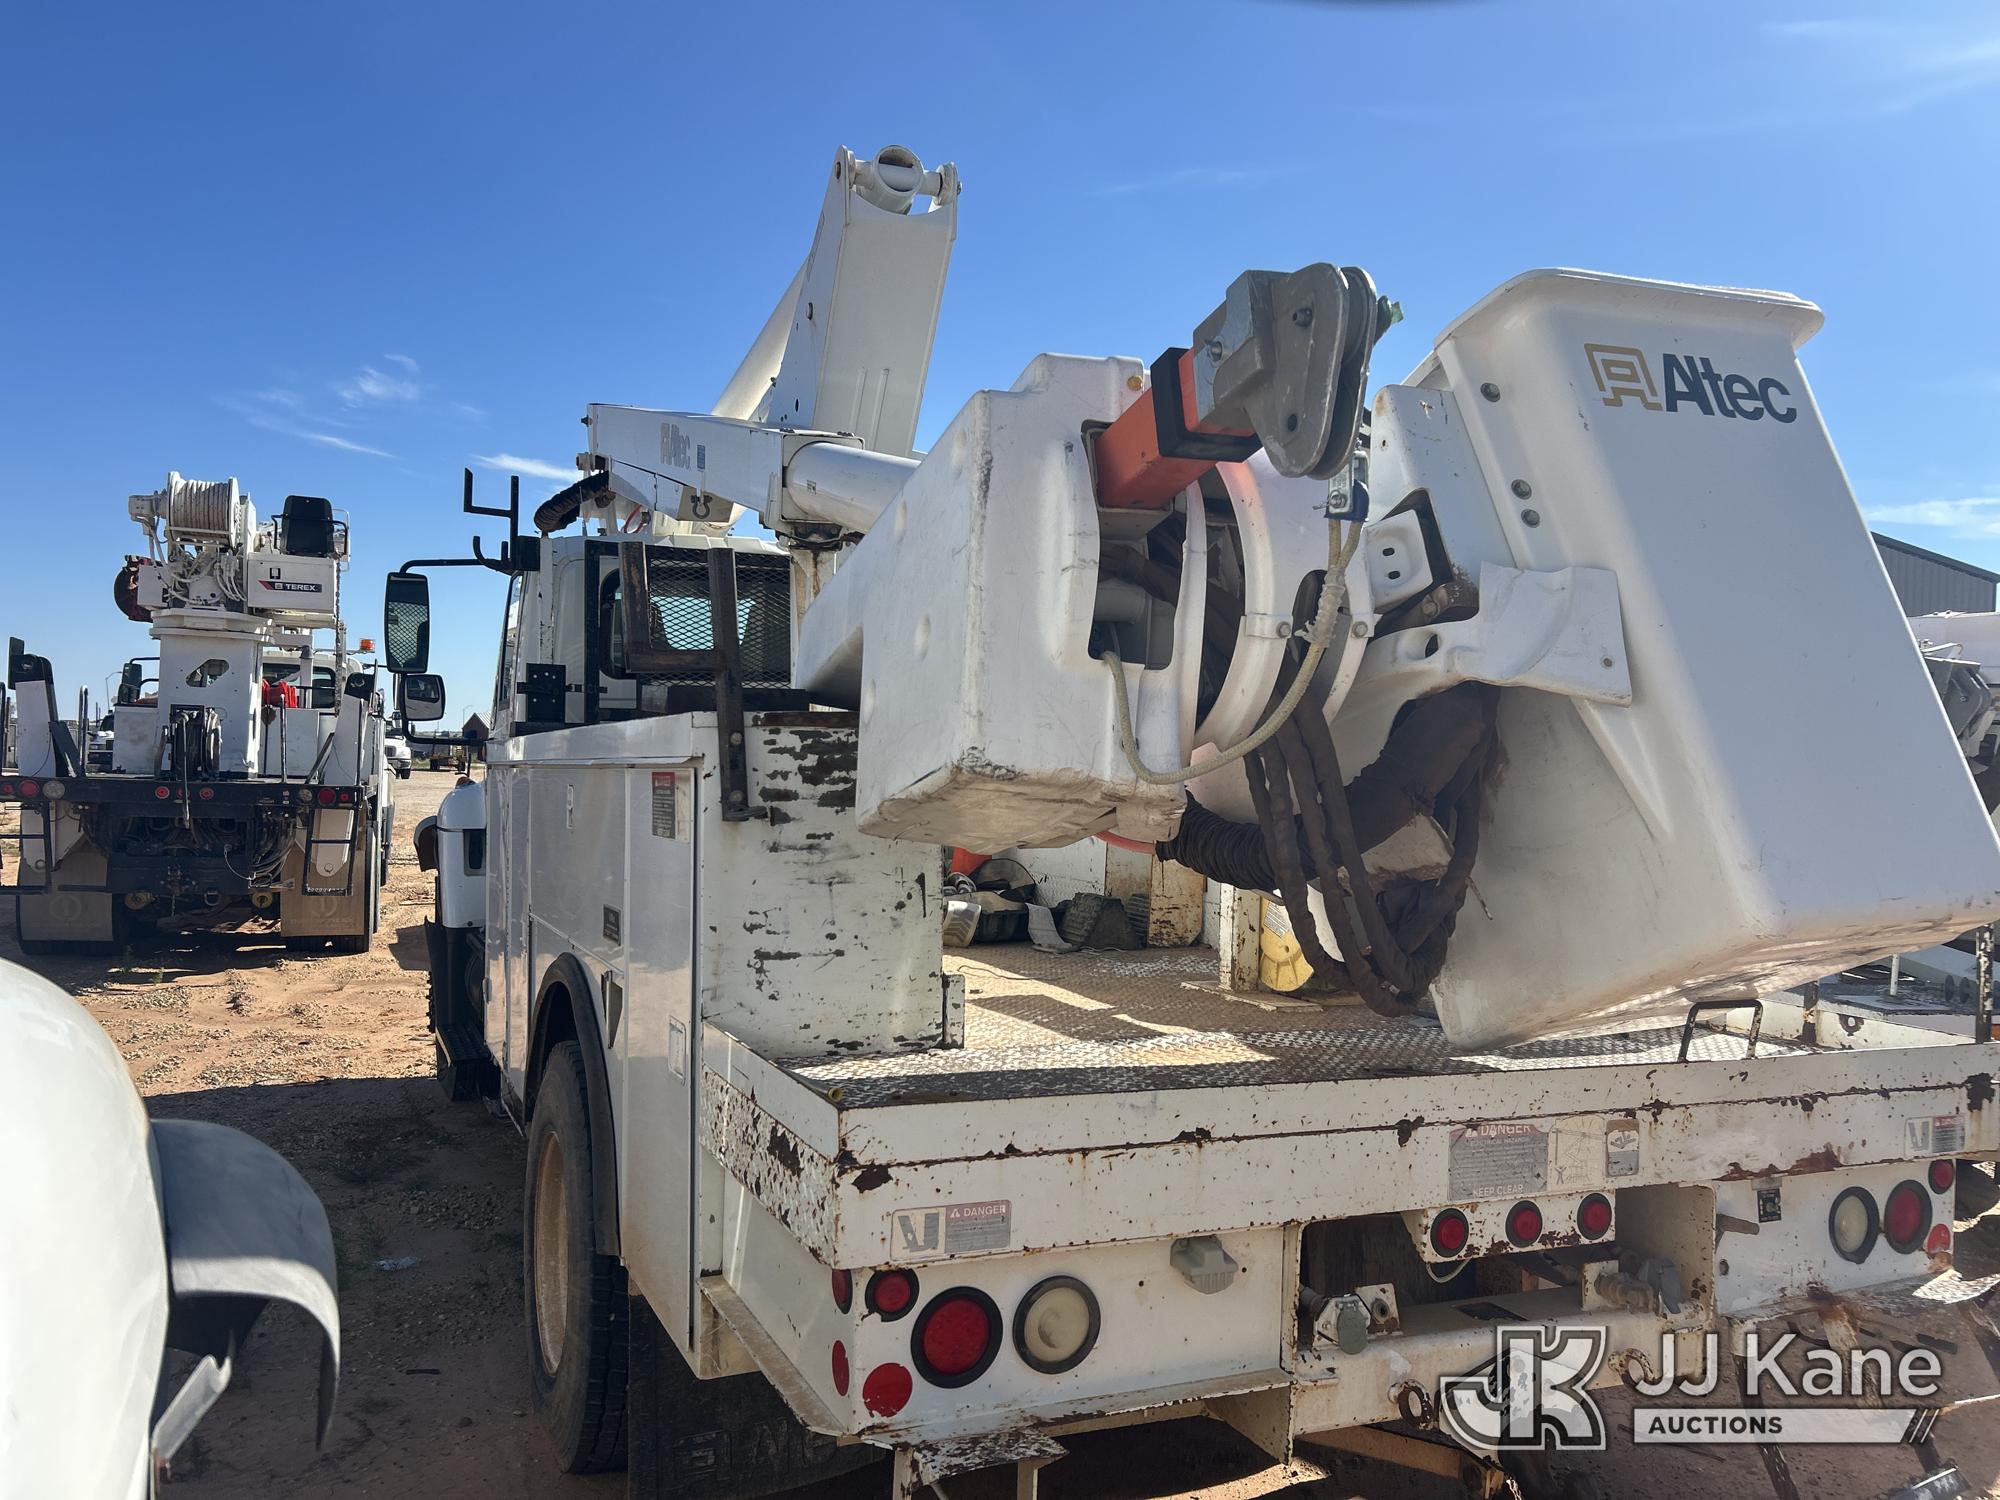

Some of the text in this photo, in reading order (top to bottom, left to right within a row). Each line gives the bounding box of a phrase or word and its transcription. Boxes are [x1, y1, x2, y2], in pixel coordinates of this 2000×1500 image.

[1663, 353, 1797, 424] Altec
[285, 583, 316, 591] TEREX
[1480, 1125, 1533, 1136] DANGER
[963, 1204, 1006, 1217] DANGER
